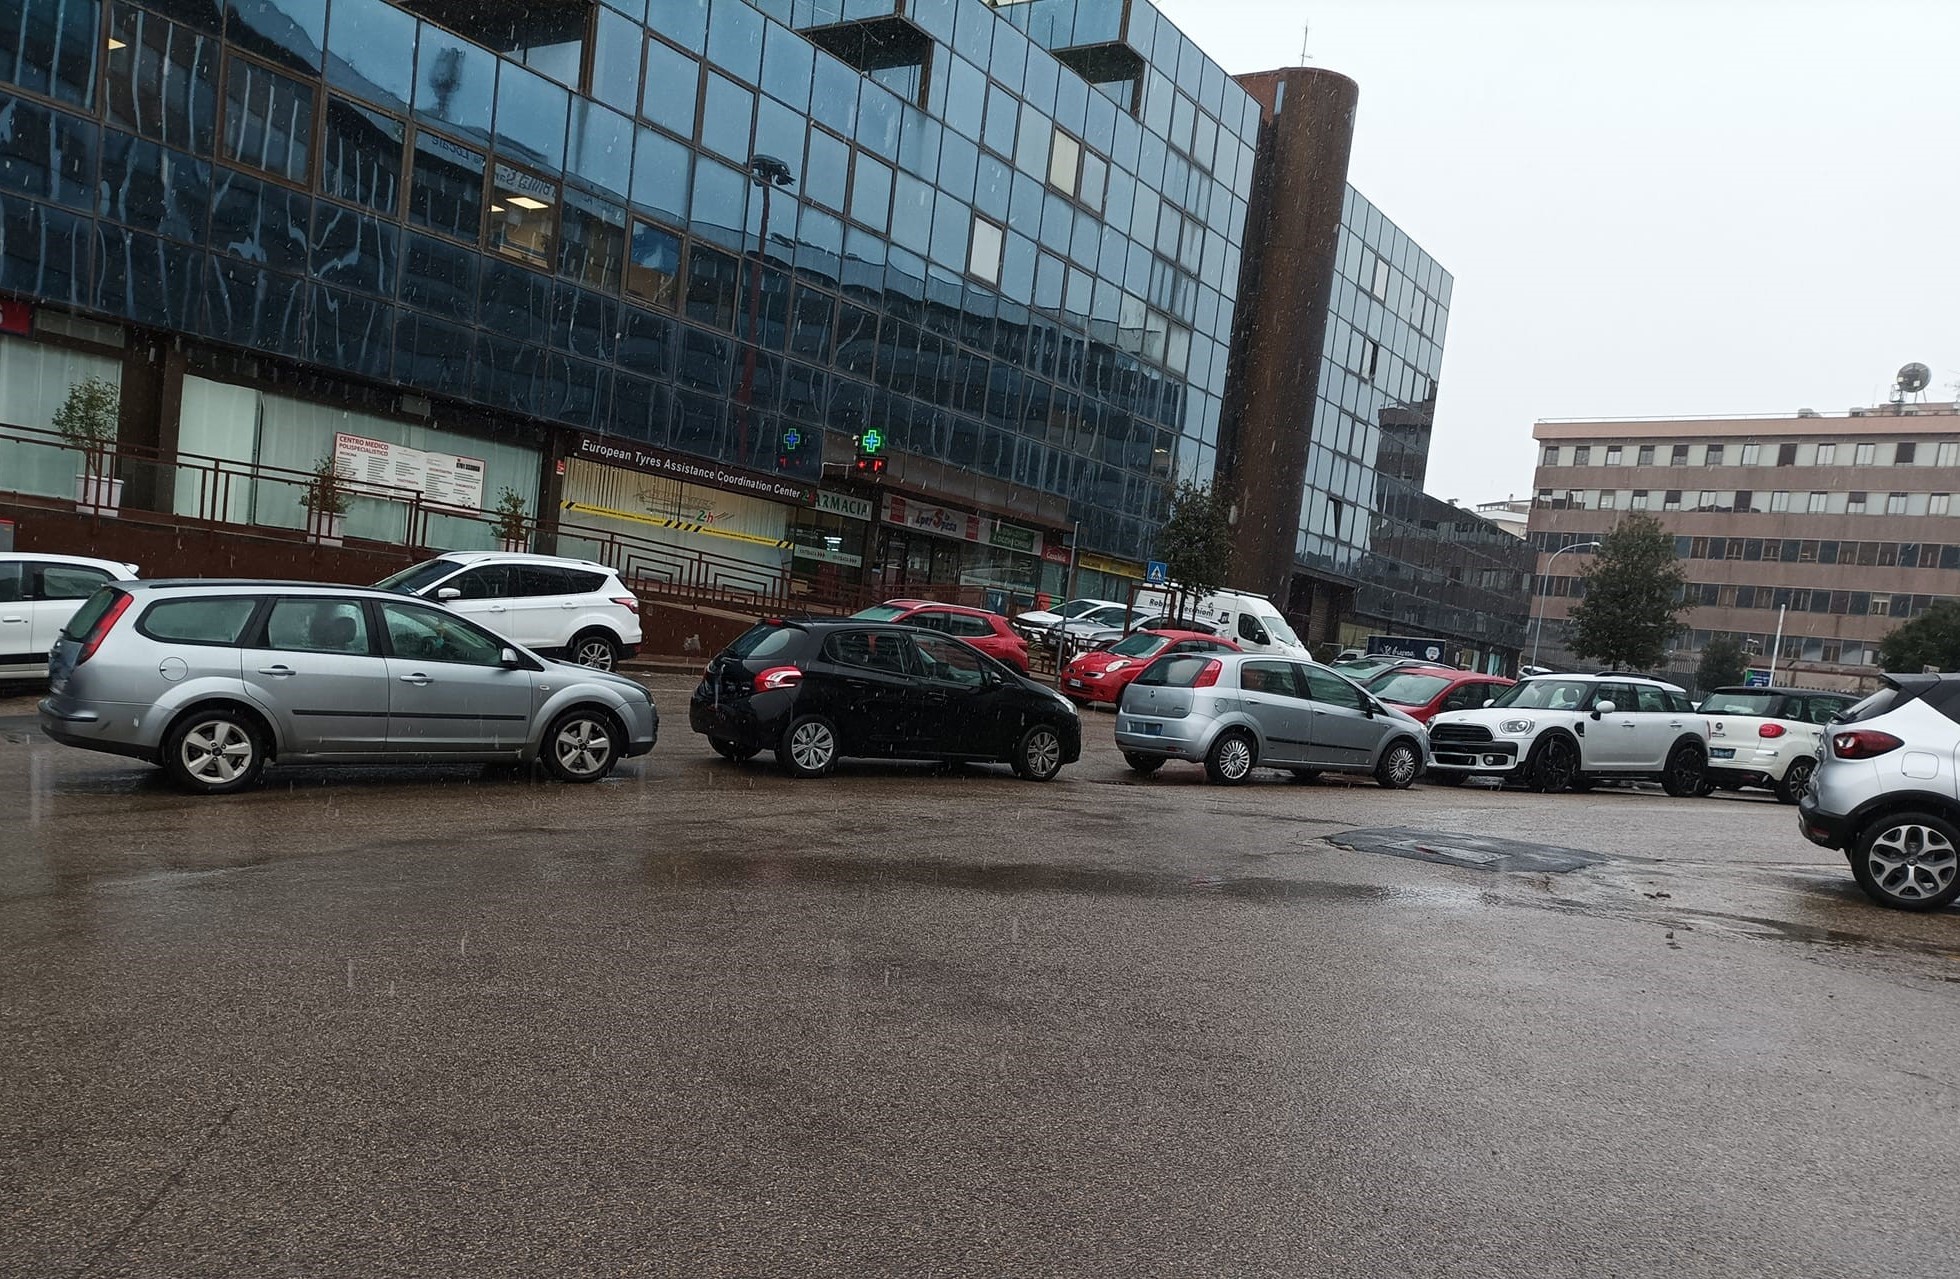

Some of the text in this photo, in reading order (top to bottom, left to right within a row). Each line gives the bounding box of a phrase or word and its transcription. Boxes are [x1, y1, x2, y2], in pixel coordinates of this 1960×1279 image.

[339, 443, 389, 456] POLISPECIALISTICO
[340, 436, 389, 450] CENTRO MEDICO
[581, 439, 632, 461] European
[635, 452, 662, 467] Tyres
[663, 459, 714, 479] Assistance
[717, 470, 772, 493] Coordination
[774, 483, 801, 498] Center
[816, 493, 869, 516] ARMACIA
